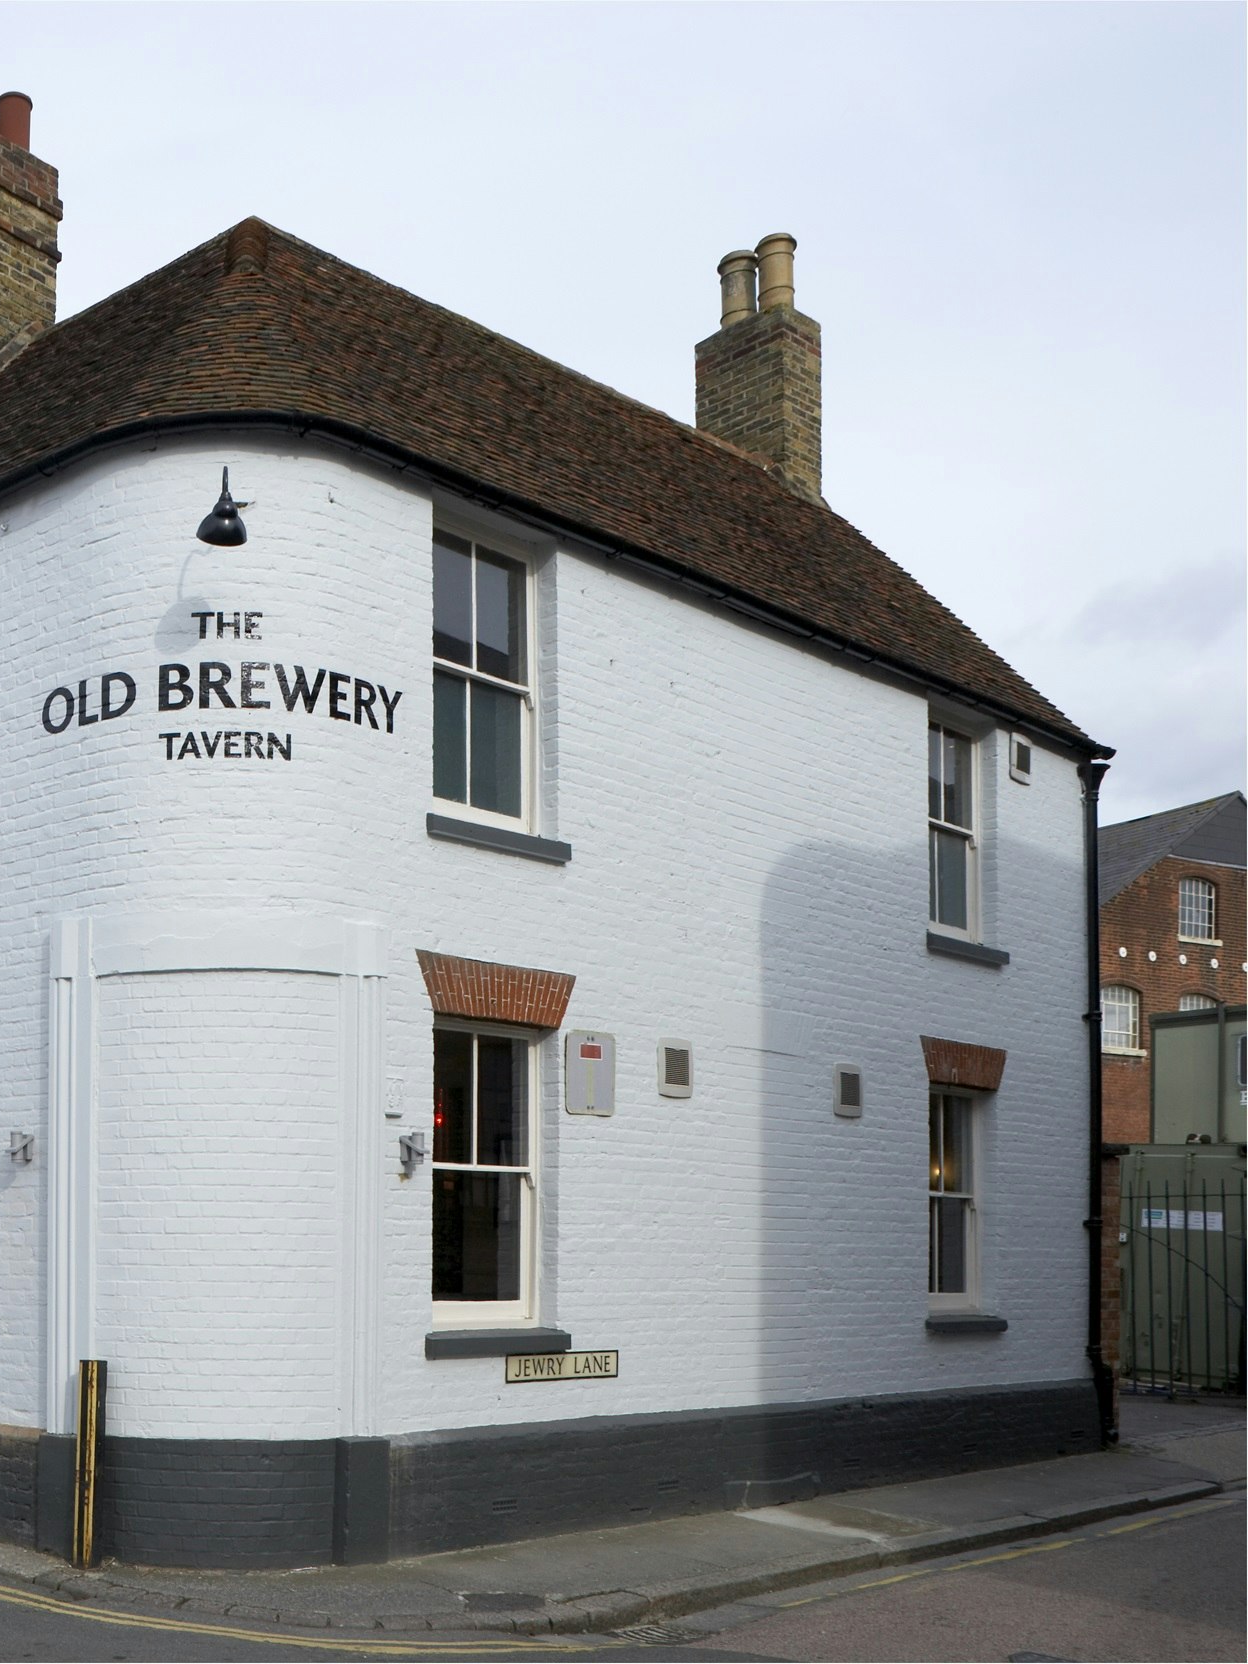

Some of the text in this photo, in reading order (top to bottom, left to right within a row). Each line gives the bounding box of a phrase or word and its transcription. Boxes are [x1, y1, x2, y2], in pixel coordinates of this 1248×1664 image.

[191, 612, 263, 640] THE
[42, 662, 403, 734] OLD BREWERY
[159, 731, 292, 761] TAVERN
[514, 1355, 611, 1378] JEWRY LANE
